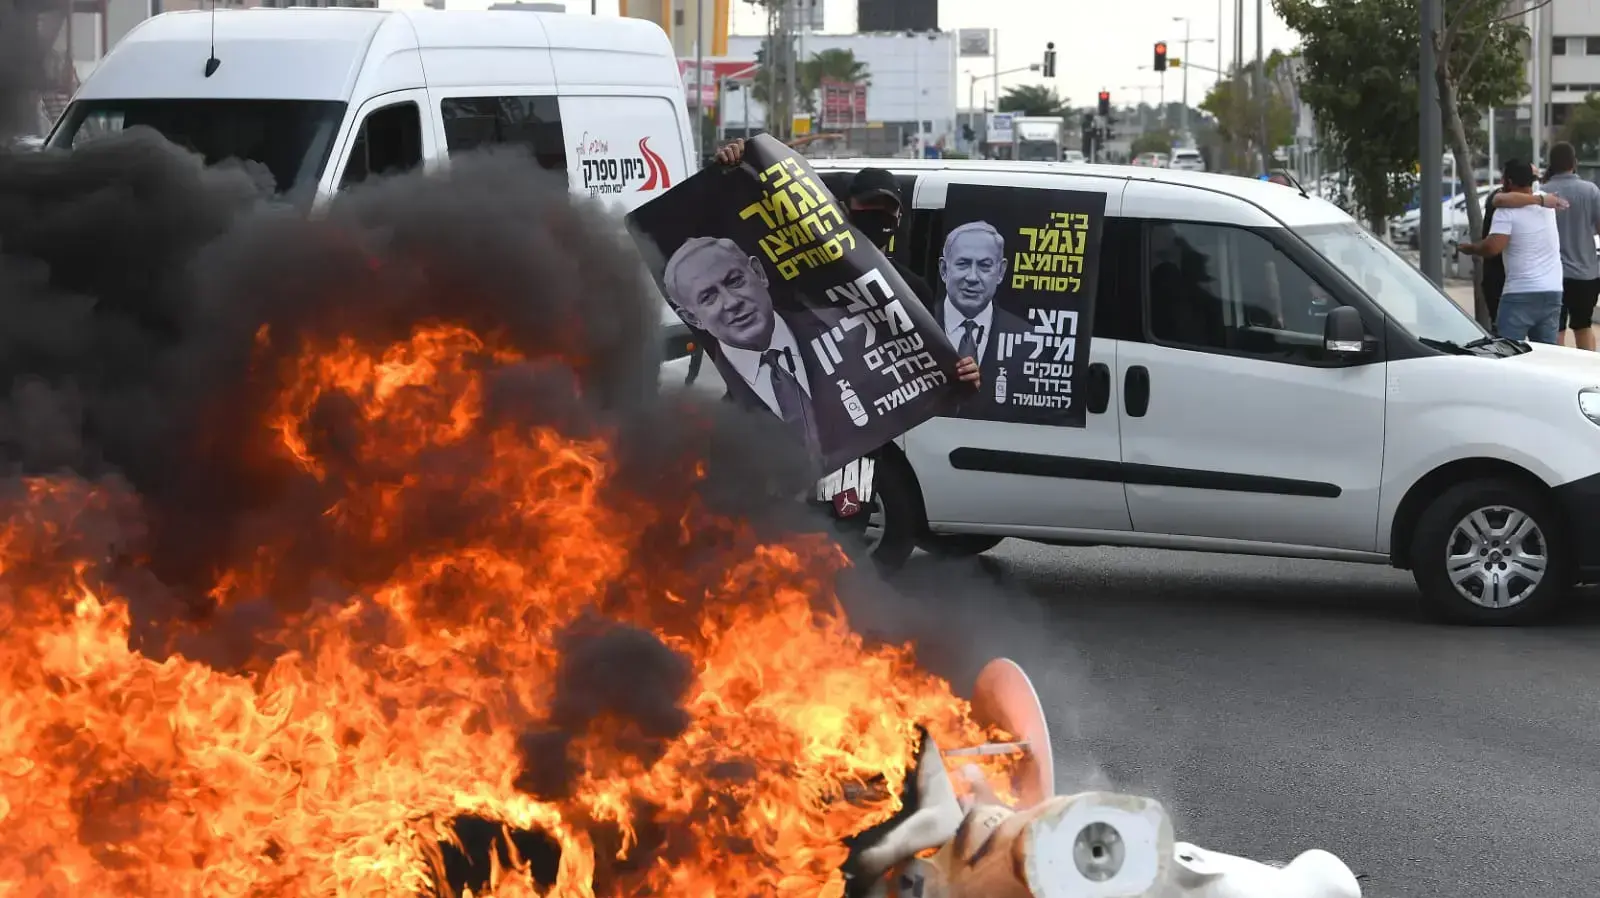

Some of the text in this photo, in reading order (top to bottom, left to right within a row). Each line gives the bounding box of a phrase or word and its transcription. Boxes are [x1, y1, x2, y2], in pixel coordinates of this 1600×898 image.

[582, 158, 646, 189] ביתן ספרק
[739, 176, 828, 230] נגמר
[758, 203, 844, 263] החמצן
[1019, 227, 1087, 254] נגמר
[776, 230, 856, 281] לסוחרים
[1013, 252, 1084, 274] החמצן
[825, 267, 895, 313] חצי
[1012, 274, 1081, 293] לסוחרים
[810, 299, 915, 376] מיליון
[1028, 308, 1079, 336] חצי
[862, 332, 925, 371] עסקים
[997, 331, 1076, 362] מיליון
[880, 351, 937, 384] בדרך
[1023, 361, 1073, 379] עסקים
[873, 370, 947, 416] להנשמה
[1012, 392, 1072, 409] להנשמה
[1028, 377, 1072, 393] בדרך
